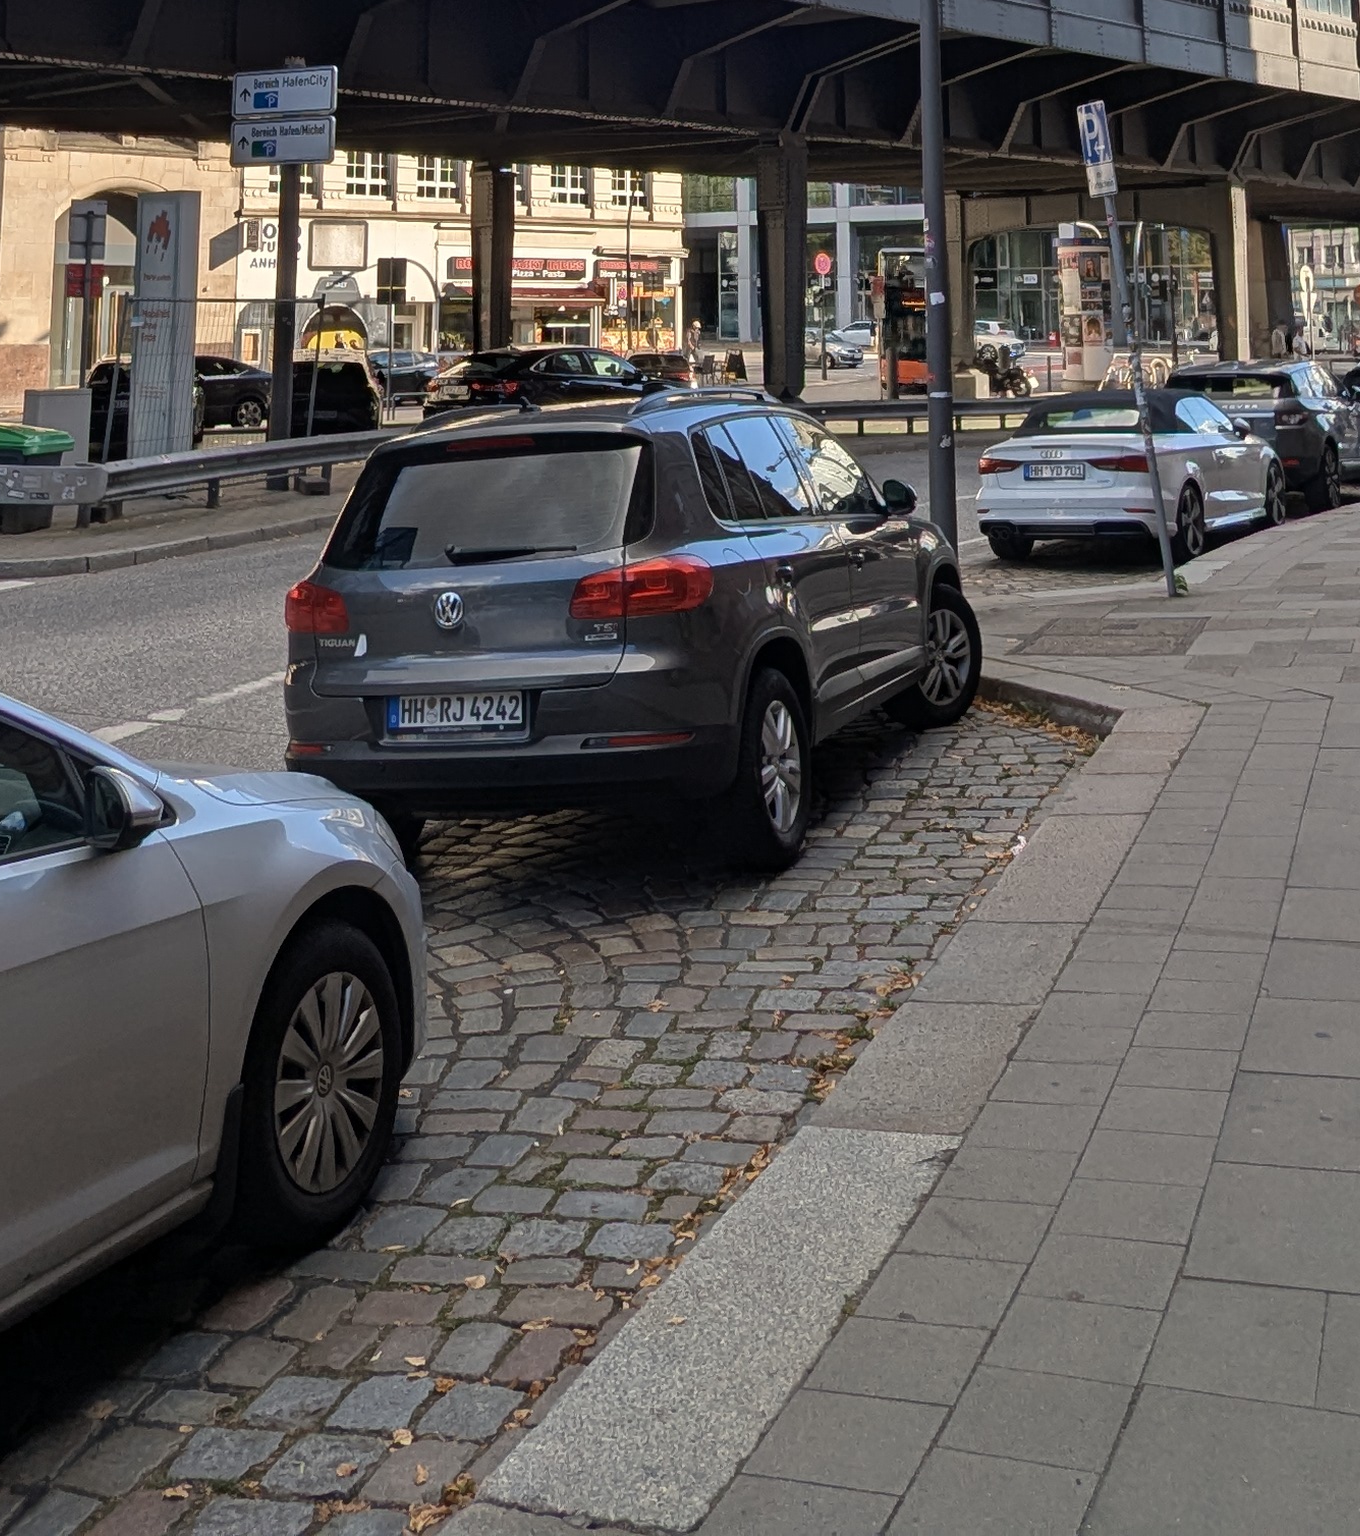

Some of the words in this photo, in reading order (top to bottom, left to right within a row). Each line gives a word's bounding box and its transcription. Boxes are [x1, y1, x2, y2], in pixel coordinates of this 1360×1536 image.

[253, 78, 279, 89] Bereich
[282, 75, 328, 87] HafenCity
[251, 127, 277, 138] Bereich
[279, 124, 325, 136] Hafen/Michel
[542, 269, 566, 278] Pasta
[1030, 465, 1043, 476] HH
[1049, 466, 1062, 476] YD
[1064, 465, 1082, 476] 701
[319, 638, 356, 648] TIGUAN
[401, 698, 425, 724] HH
[440, 697, 465, 723] RJ
[470, 695, 521, 721] 4242
